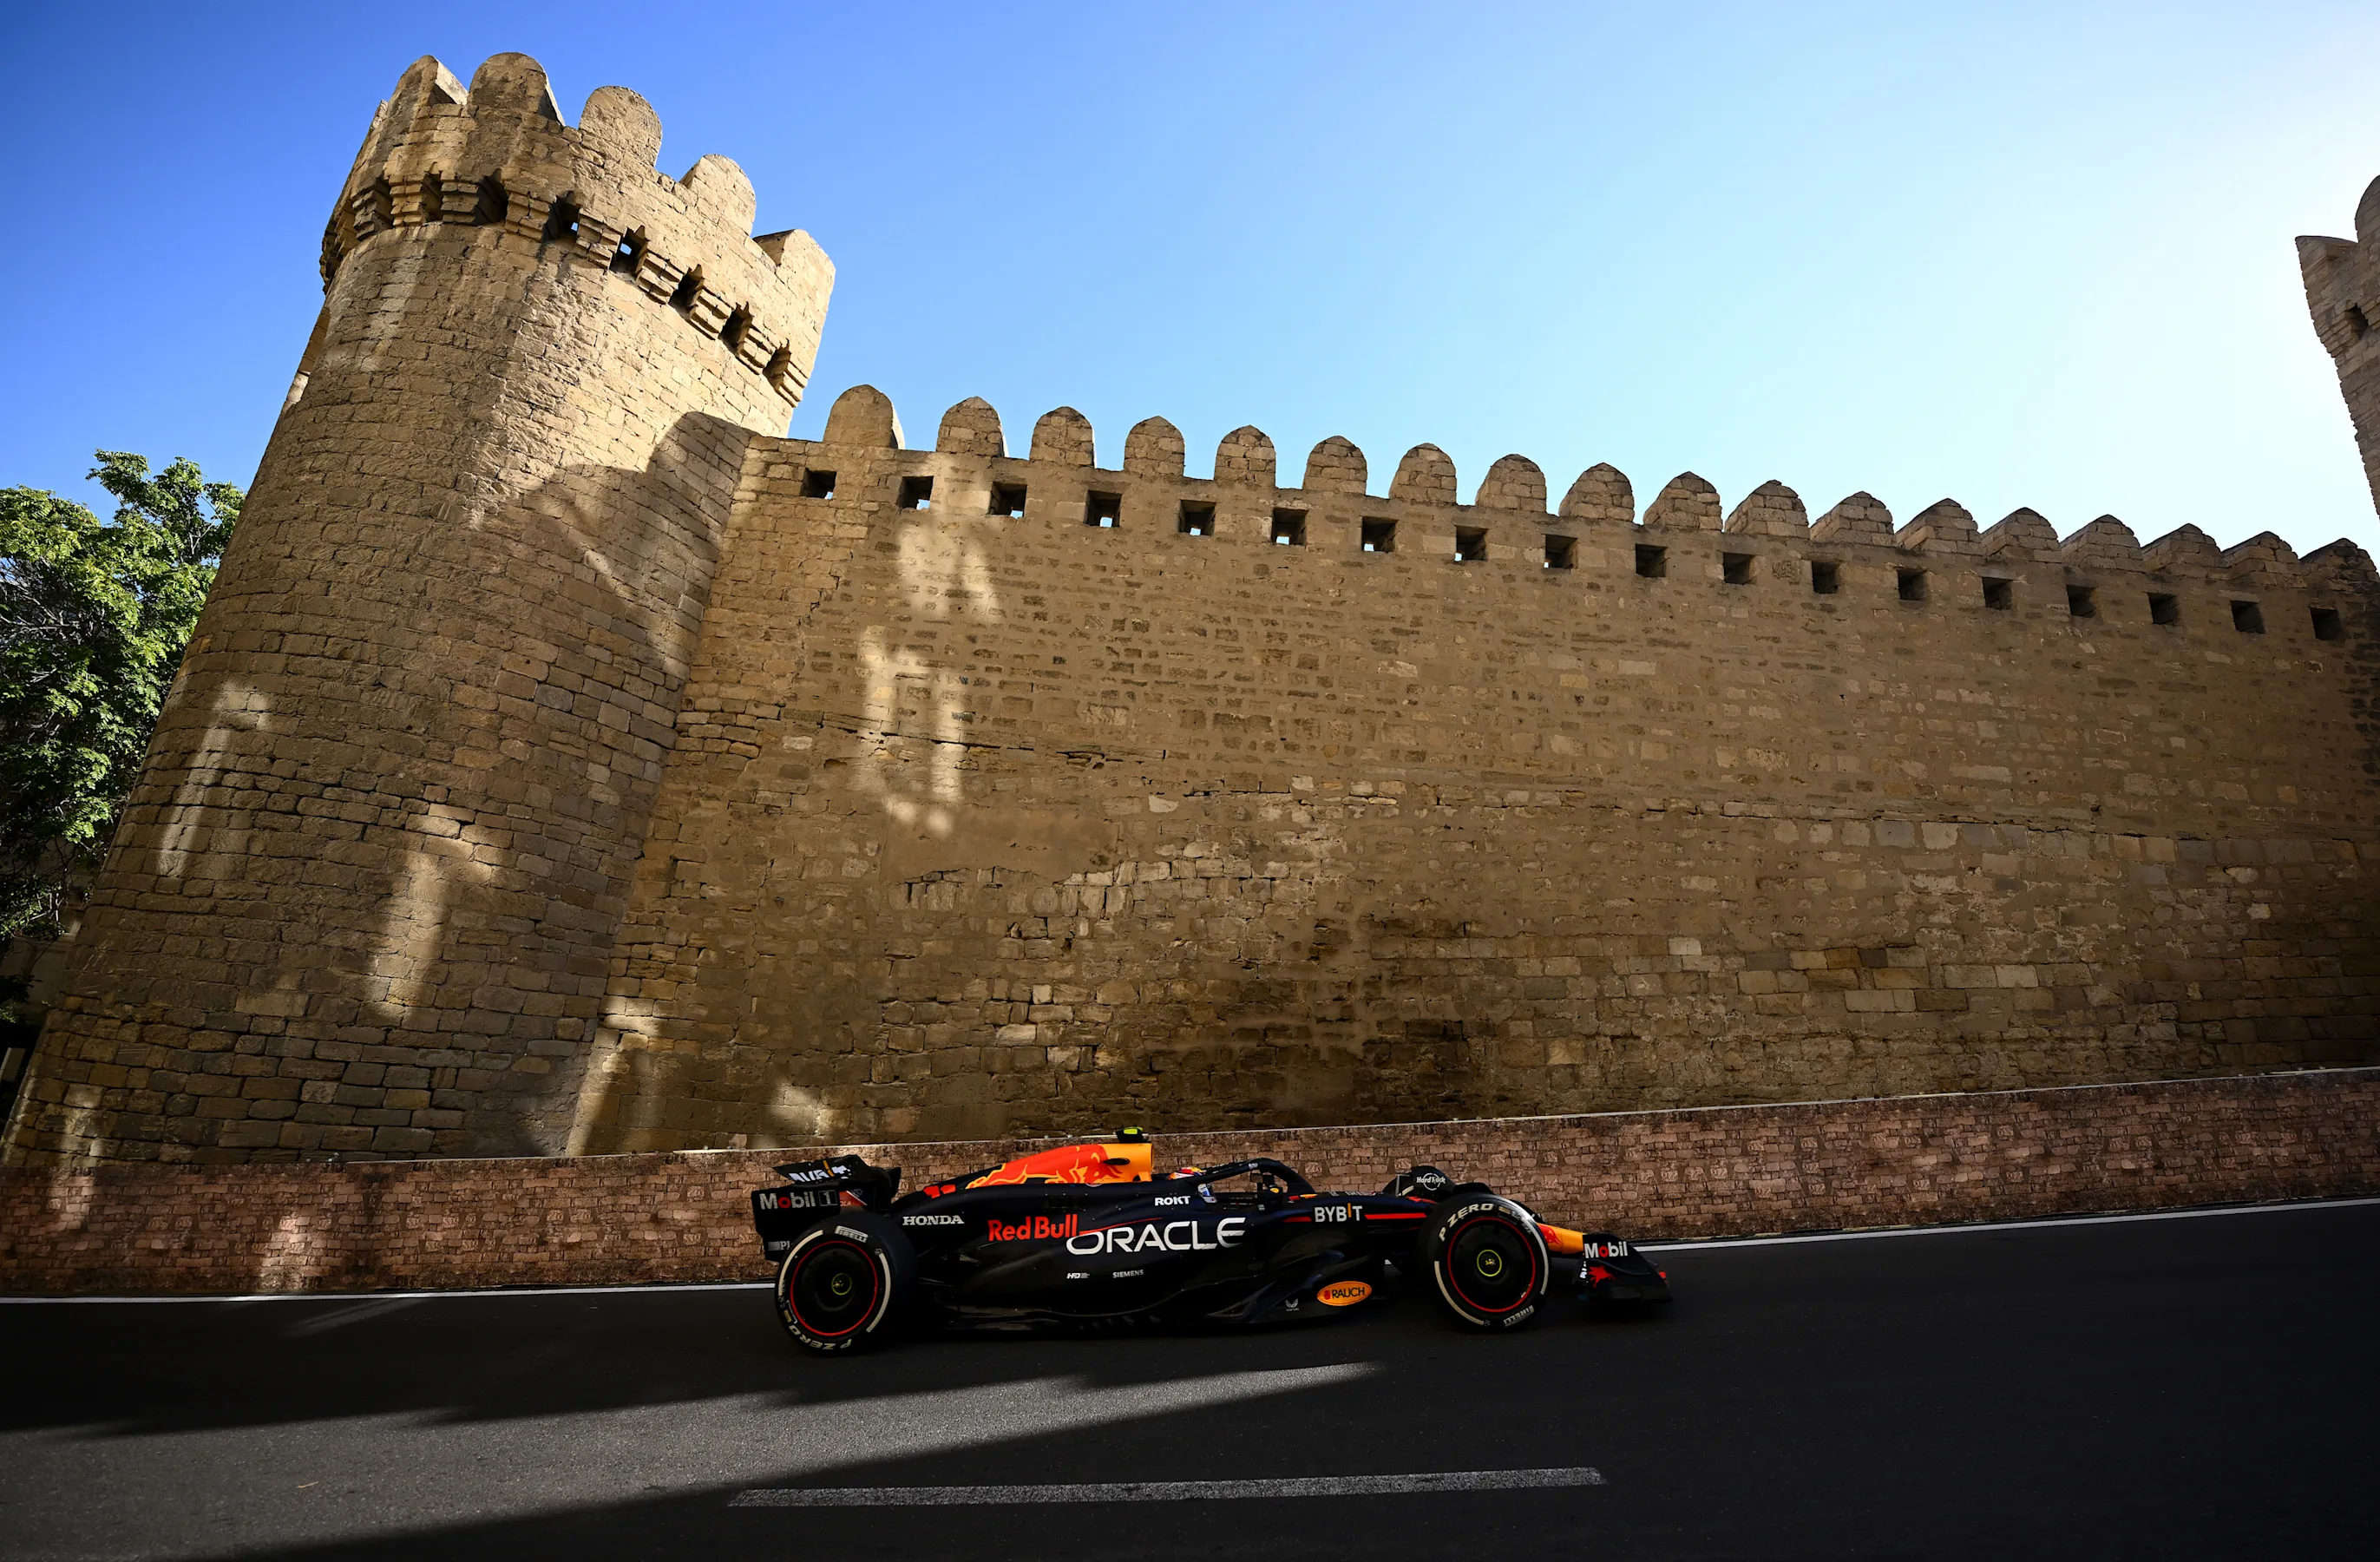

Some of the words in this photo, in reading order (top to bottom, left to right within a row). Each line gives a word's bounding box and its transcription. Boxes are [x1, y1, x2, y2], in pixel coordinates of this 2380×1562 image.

[758, 1190, 816, 1210] Mobil
[1154, 1195, 1191, 1207] ROKT
[902, 1214, 965, 1226] HONDA
[1314, 1202, 1363, 1223] BYBIT
[1438, 1226, 1447, 1242] P
[1446, 1203, 1494, 1228] ZERO
[834, 1224, 869, 1244] PIRELLI
[1065, 1217, 1247, 1256] ORACLE
[1583, 1240, 1629, 1259] Mobil
[1111, 1269, 1144, 1279] SIEMENS
[1332, 1286, 1365, 1299] RAUCH
[788, 1324, 836, 1350] ZERO
[840, 1339, 852, 1349] P
